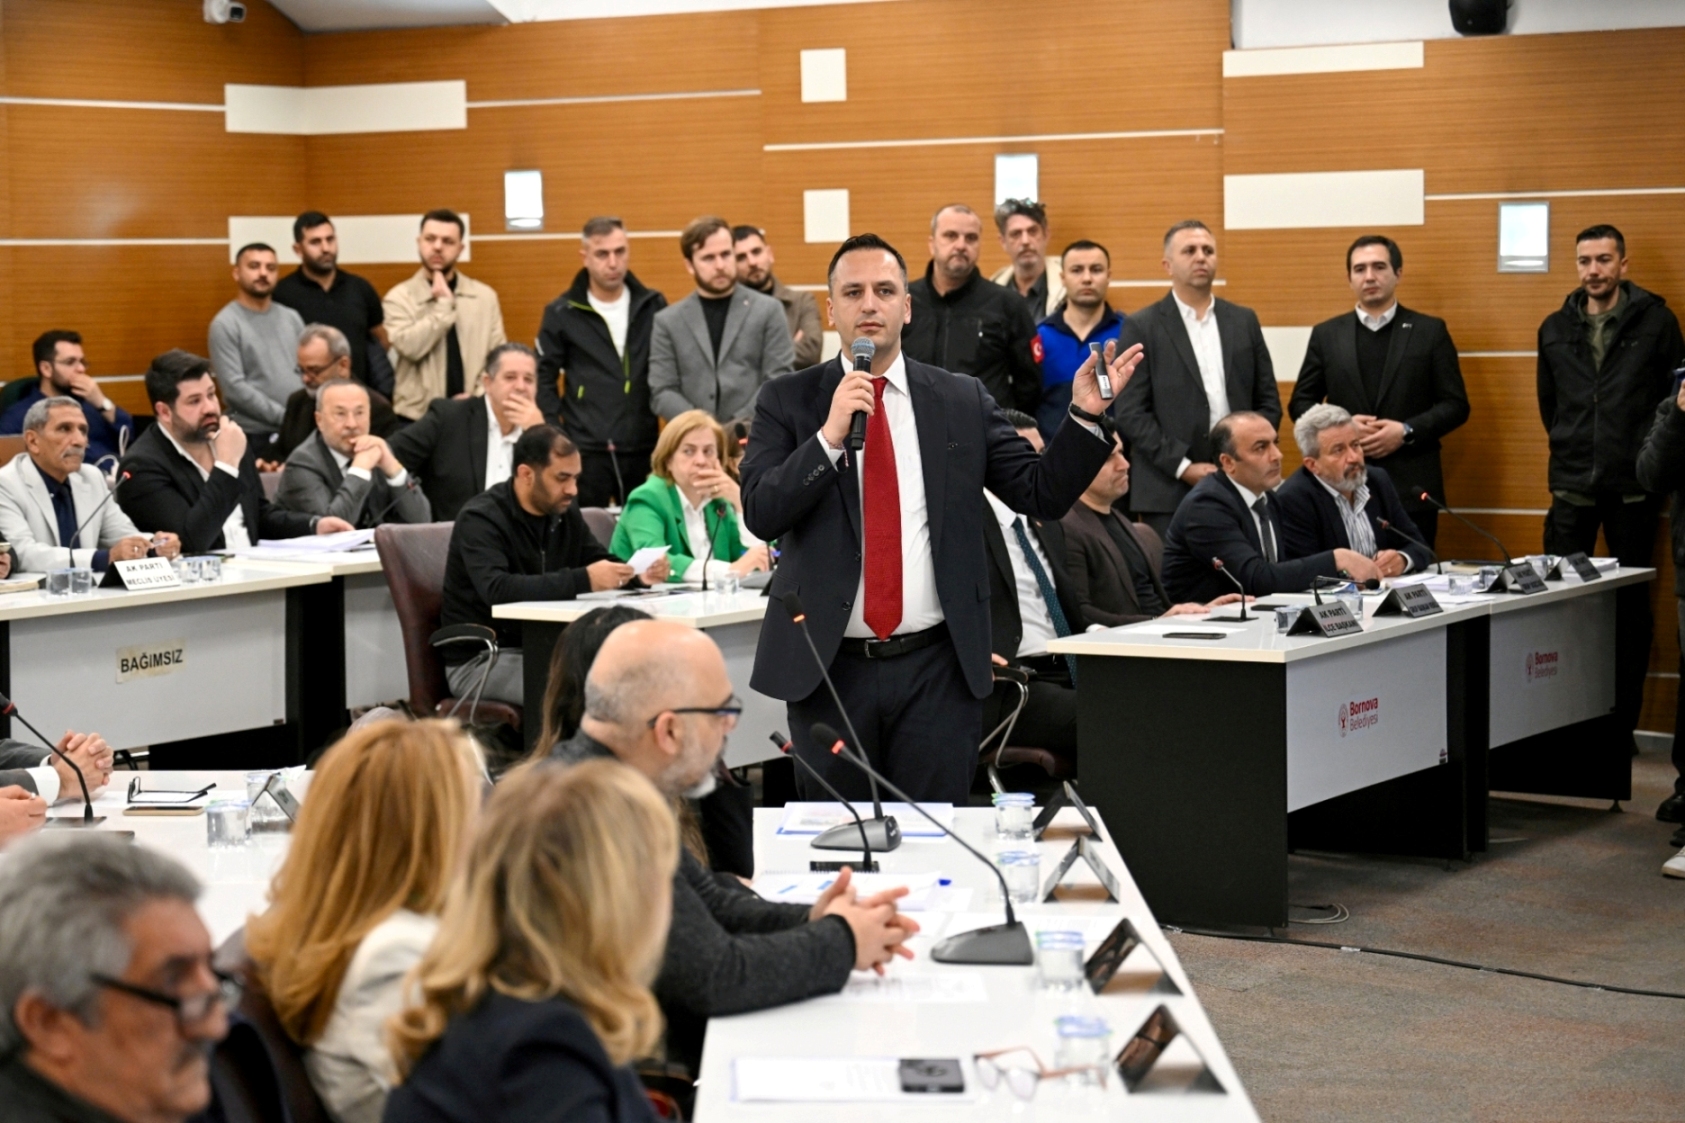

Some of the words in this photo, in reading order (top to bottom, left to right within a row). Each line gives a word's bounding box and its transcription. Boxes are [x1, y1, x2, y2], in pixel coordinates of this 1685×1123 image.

[1319, 611, 1329, 619] AK
[120, 648, 183, 673] BAĞIMSIZ
[1350, 697, 1378, 716] Bornova
[1350, 711, 1378, 731] Belediyesi
